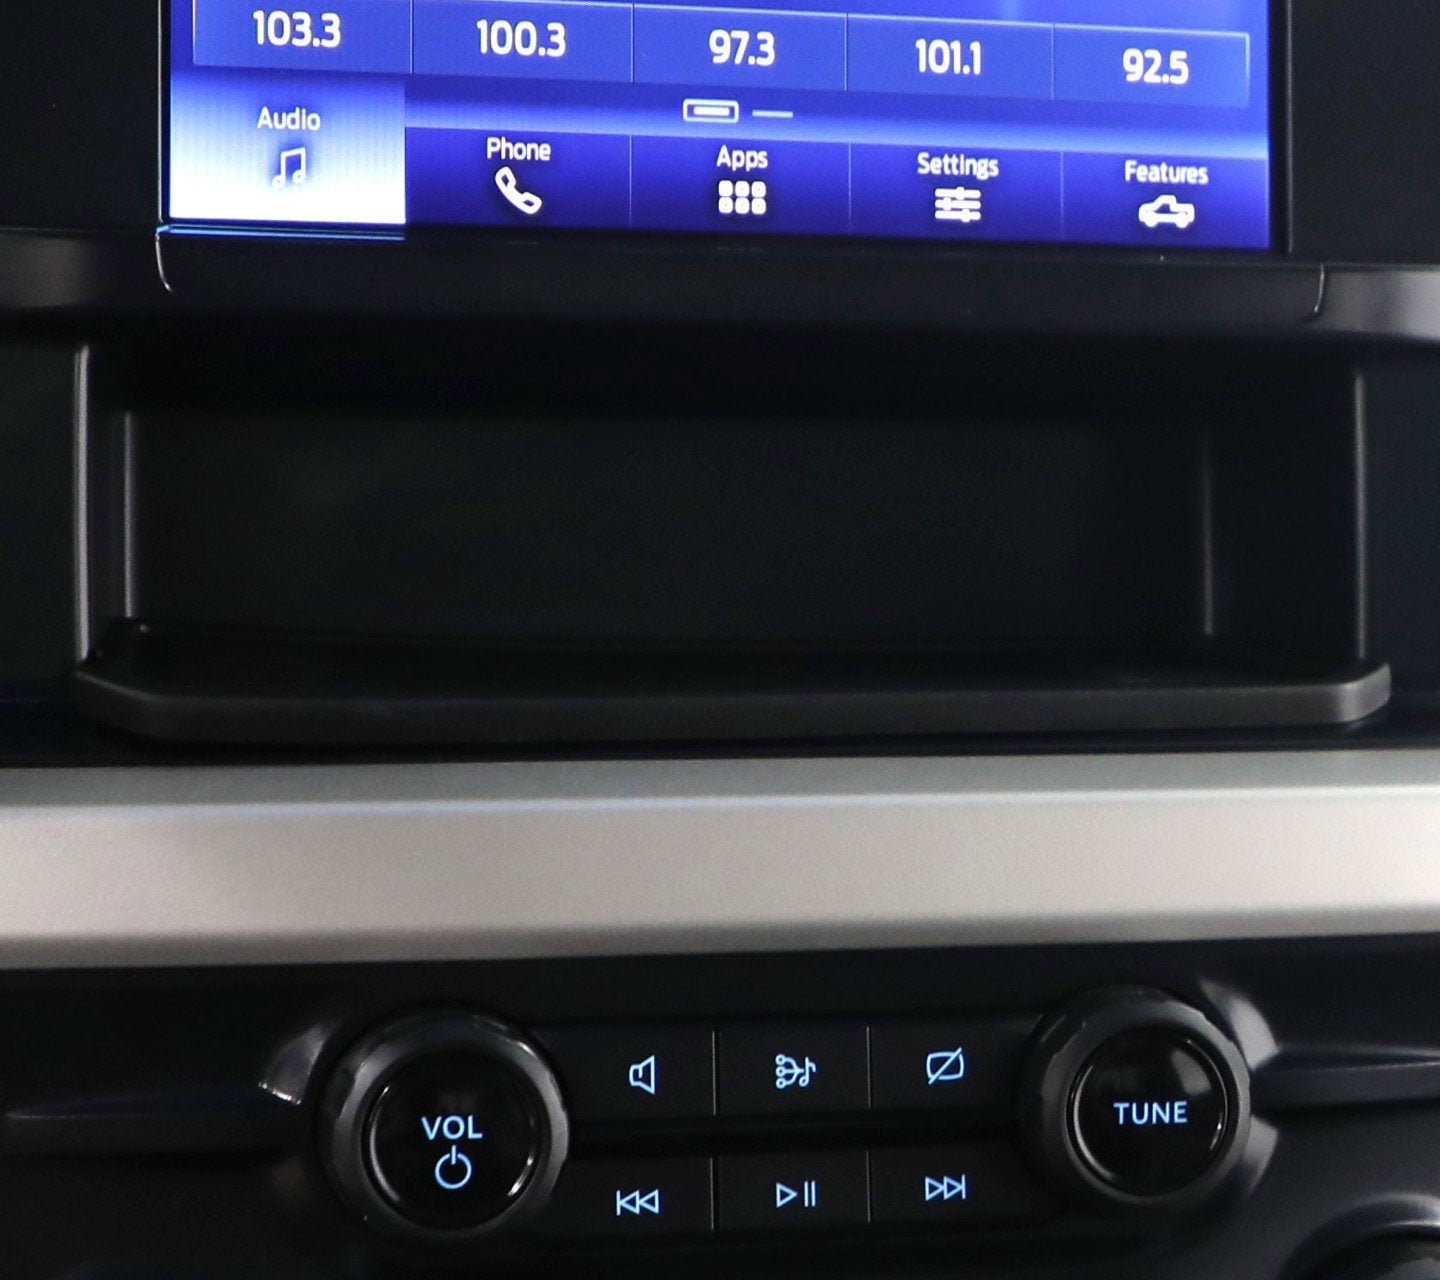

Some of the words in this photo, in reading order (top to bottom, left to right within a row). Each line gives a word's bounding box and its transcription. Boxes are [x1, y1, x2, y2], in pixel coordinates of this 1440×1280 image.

[252, 10, 342, 49] 103.3
[476, 19, 567, 58] 100.3
[709, 29, 776, 67] 97.3
[915, 38, 982, 76] 101.1
[1122, 48, 1190, 85] 92.5
[256, 106, 322, 131] Audio
[486, 136, 552, 162] Phone
[716, 144, 769, 172] Apps
[917, 151, 1000, 181] Settings
[1124, 159, 1209, 185] Features
[1113, 1100, 1187, 1125] TUNE
[421, 1115, 483, 1140] VOL
